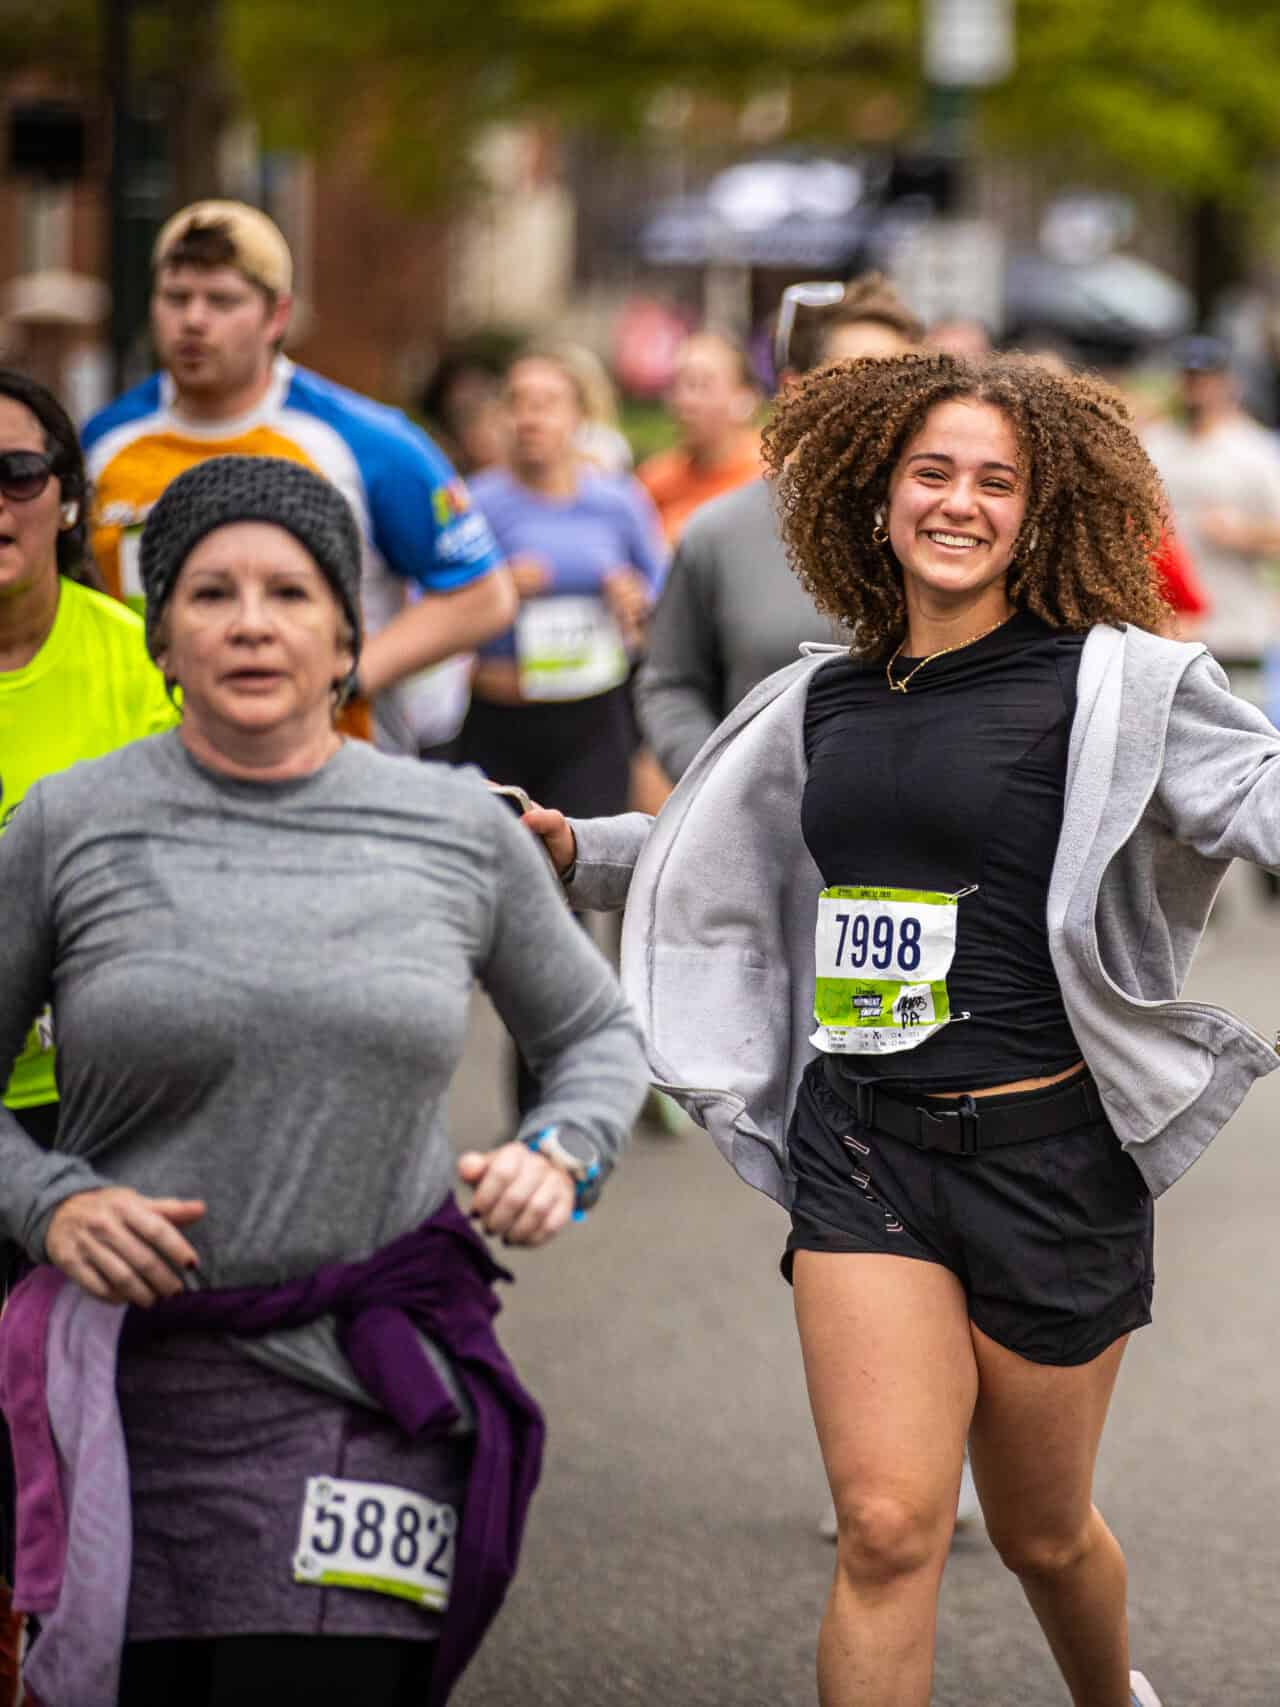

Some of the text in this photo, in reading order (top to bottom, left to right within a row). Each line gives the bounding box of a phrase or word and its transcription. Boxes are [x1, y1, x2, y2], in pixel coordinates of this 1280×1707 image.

[835, 913, 922, 971] 7998
[901, 1012, 920, 1029] PA
[312, 1493, 449, 1578] 5882
